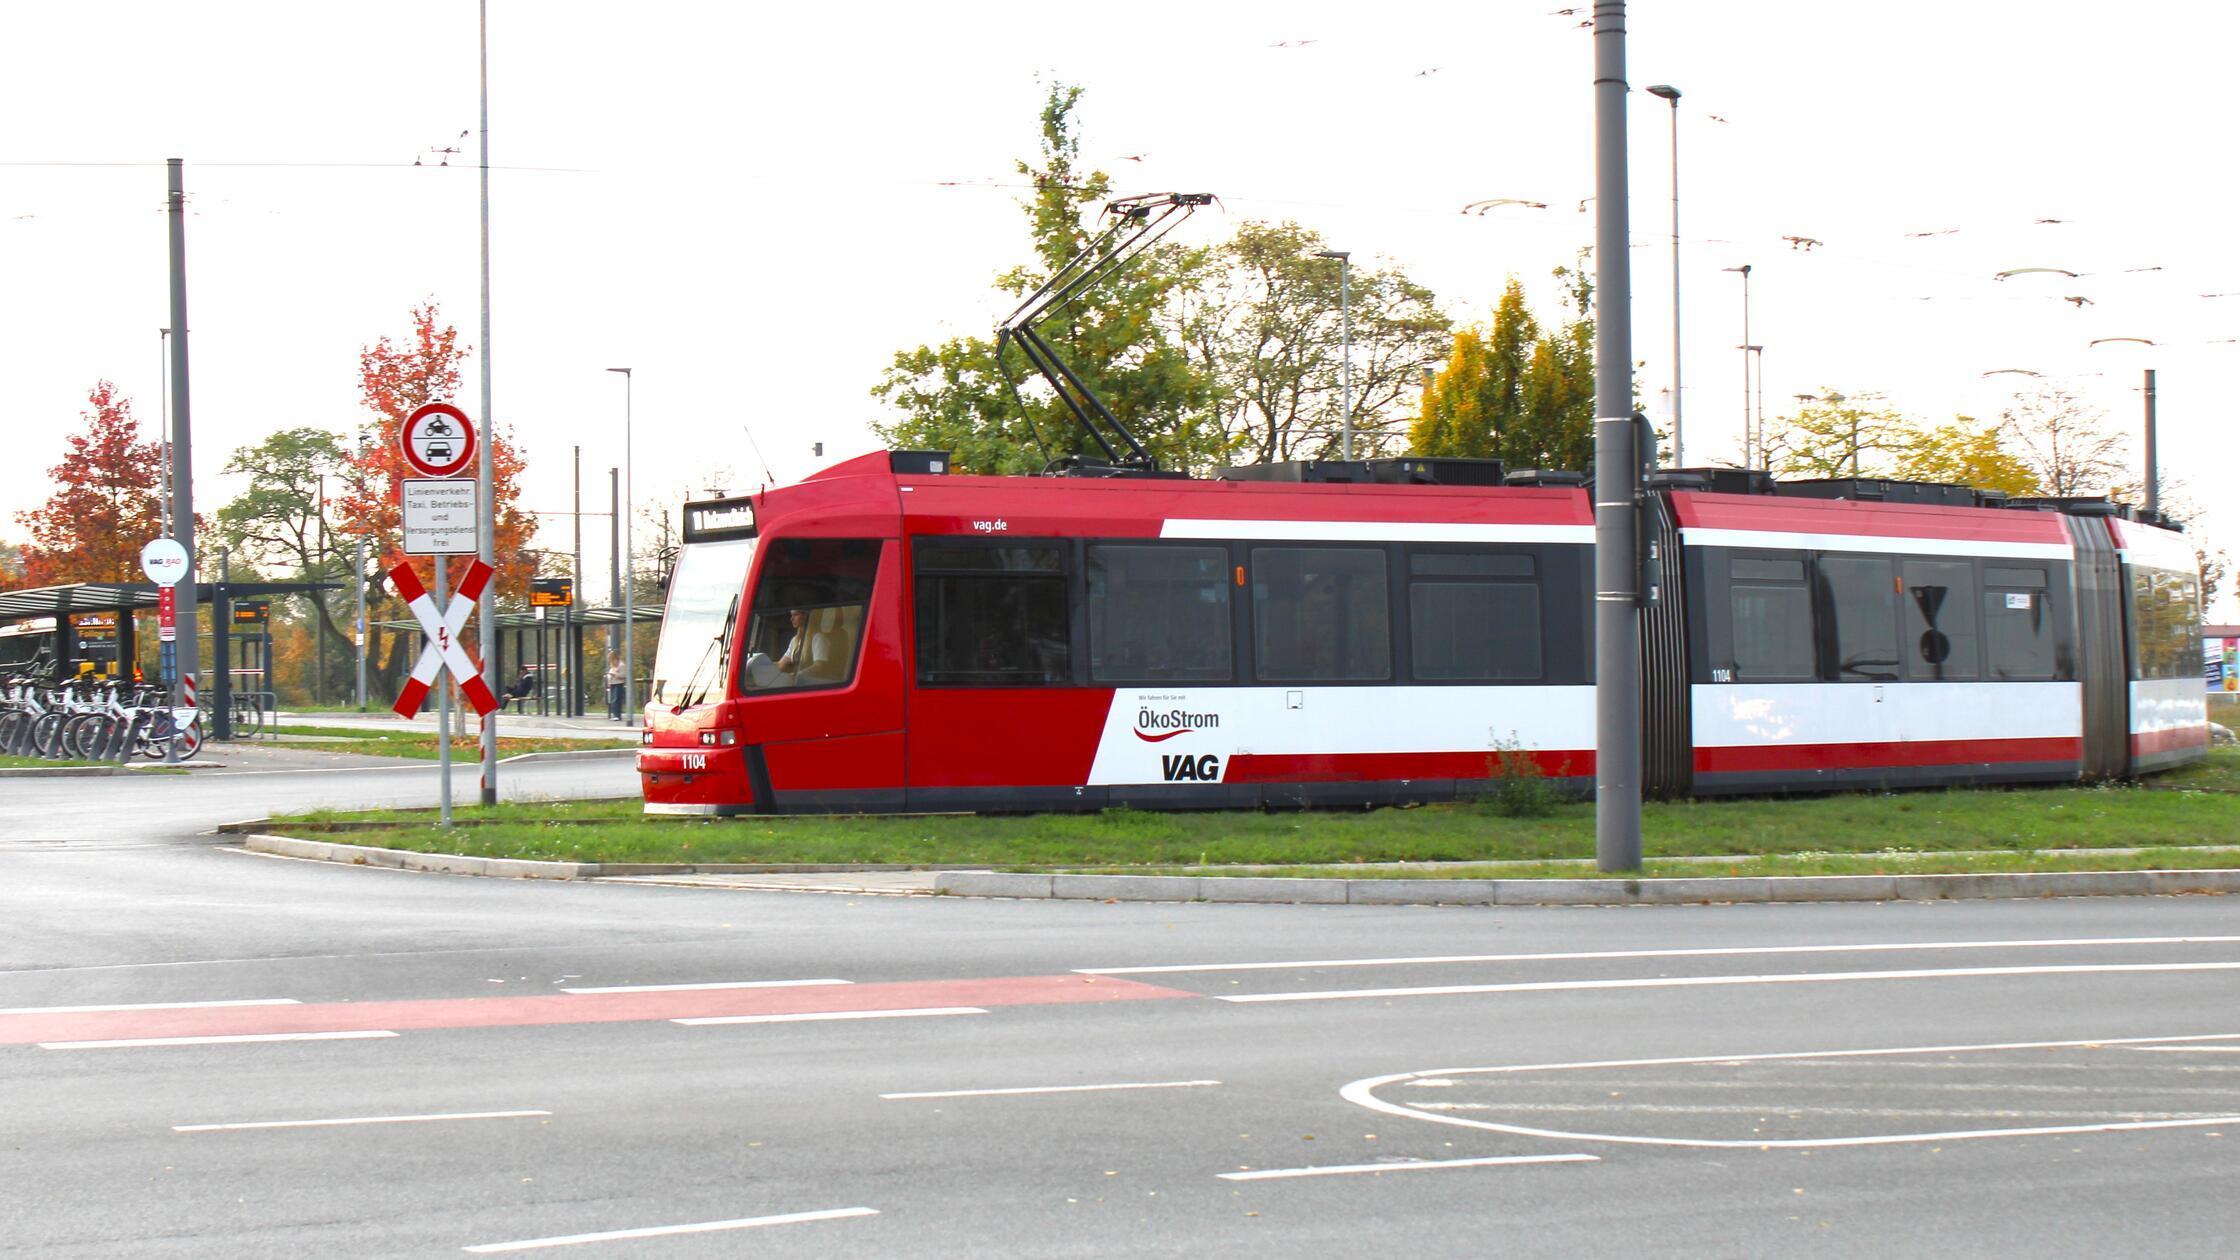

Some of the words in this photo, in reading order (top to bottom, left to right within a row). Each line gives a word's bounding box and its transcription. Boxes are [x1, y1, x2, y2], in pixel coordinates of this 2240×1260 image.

[431, 513, 449, 521] und
[973, 518, 1007, 533] vag.de
[433, 539, 449, 547] frei
[1712, 669, 1731, 683] 1104
[1138, 706, 1219, 728] ÖkoStrom
[682, 753, 706, 770] 1104
[1162, 754, 1219, 781] VAG
